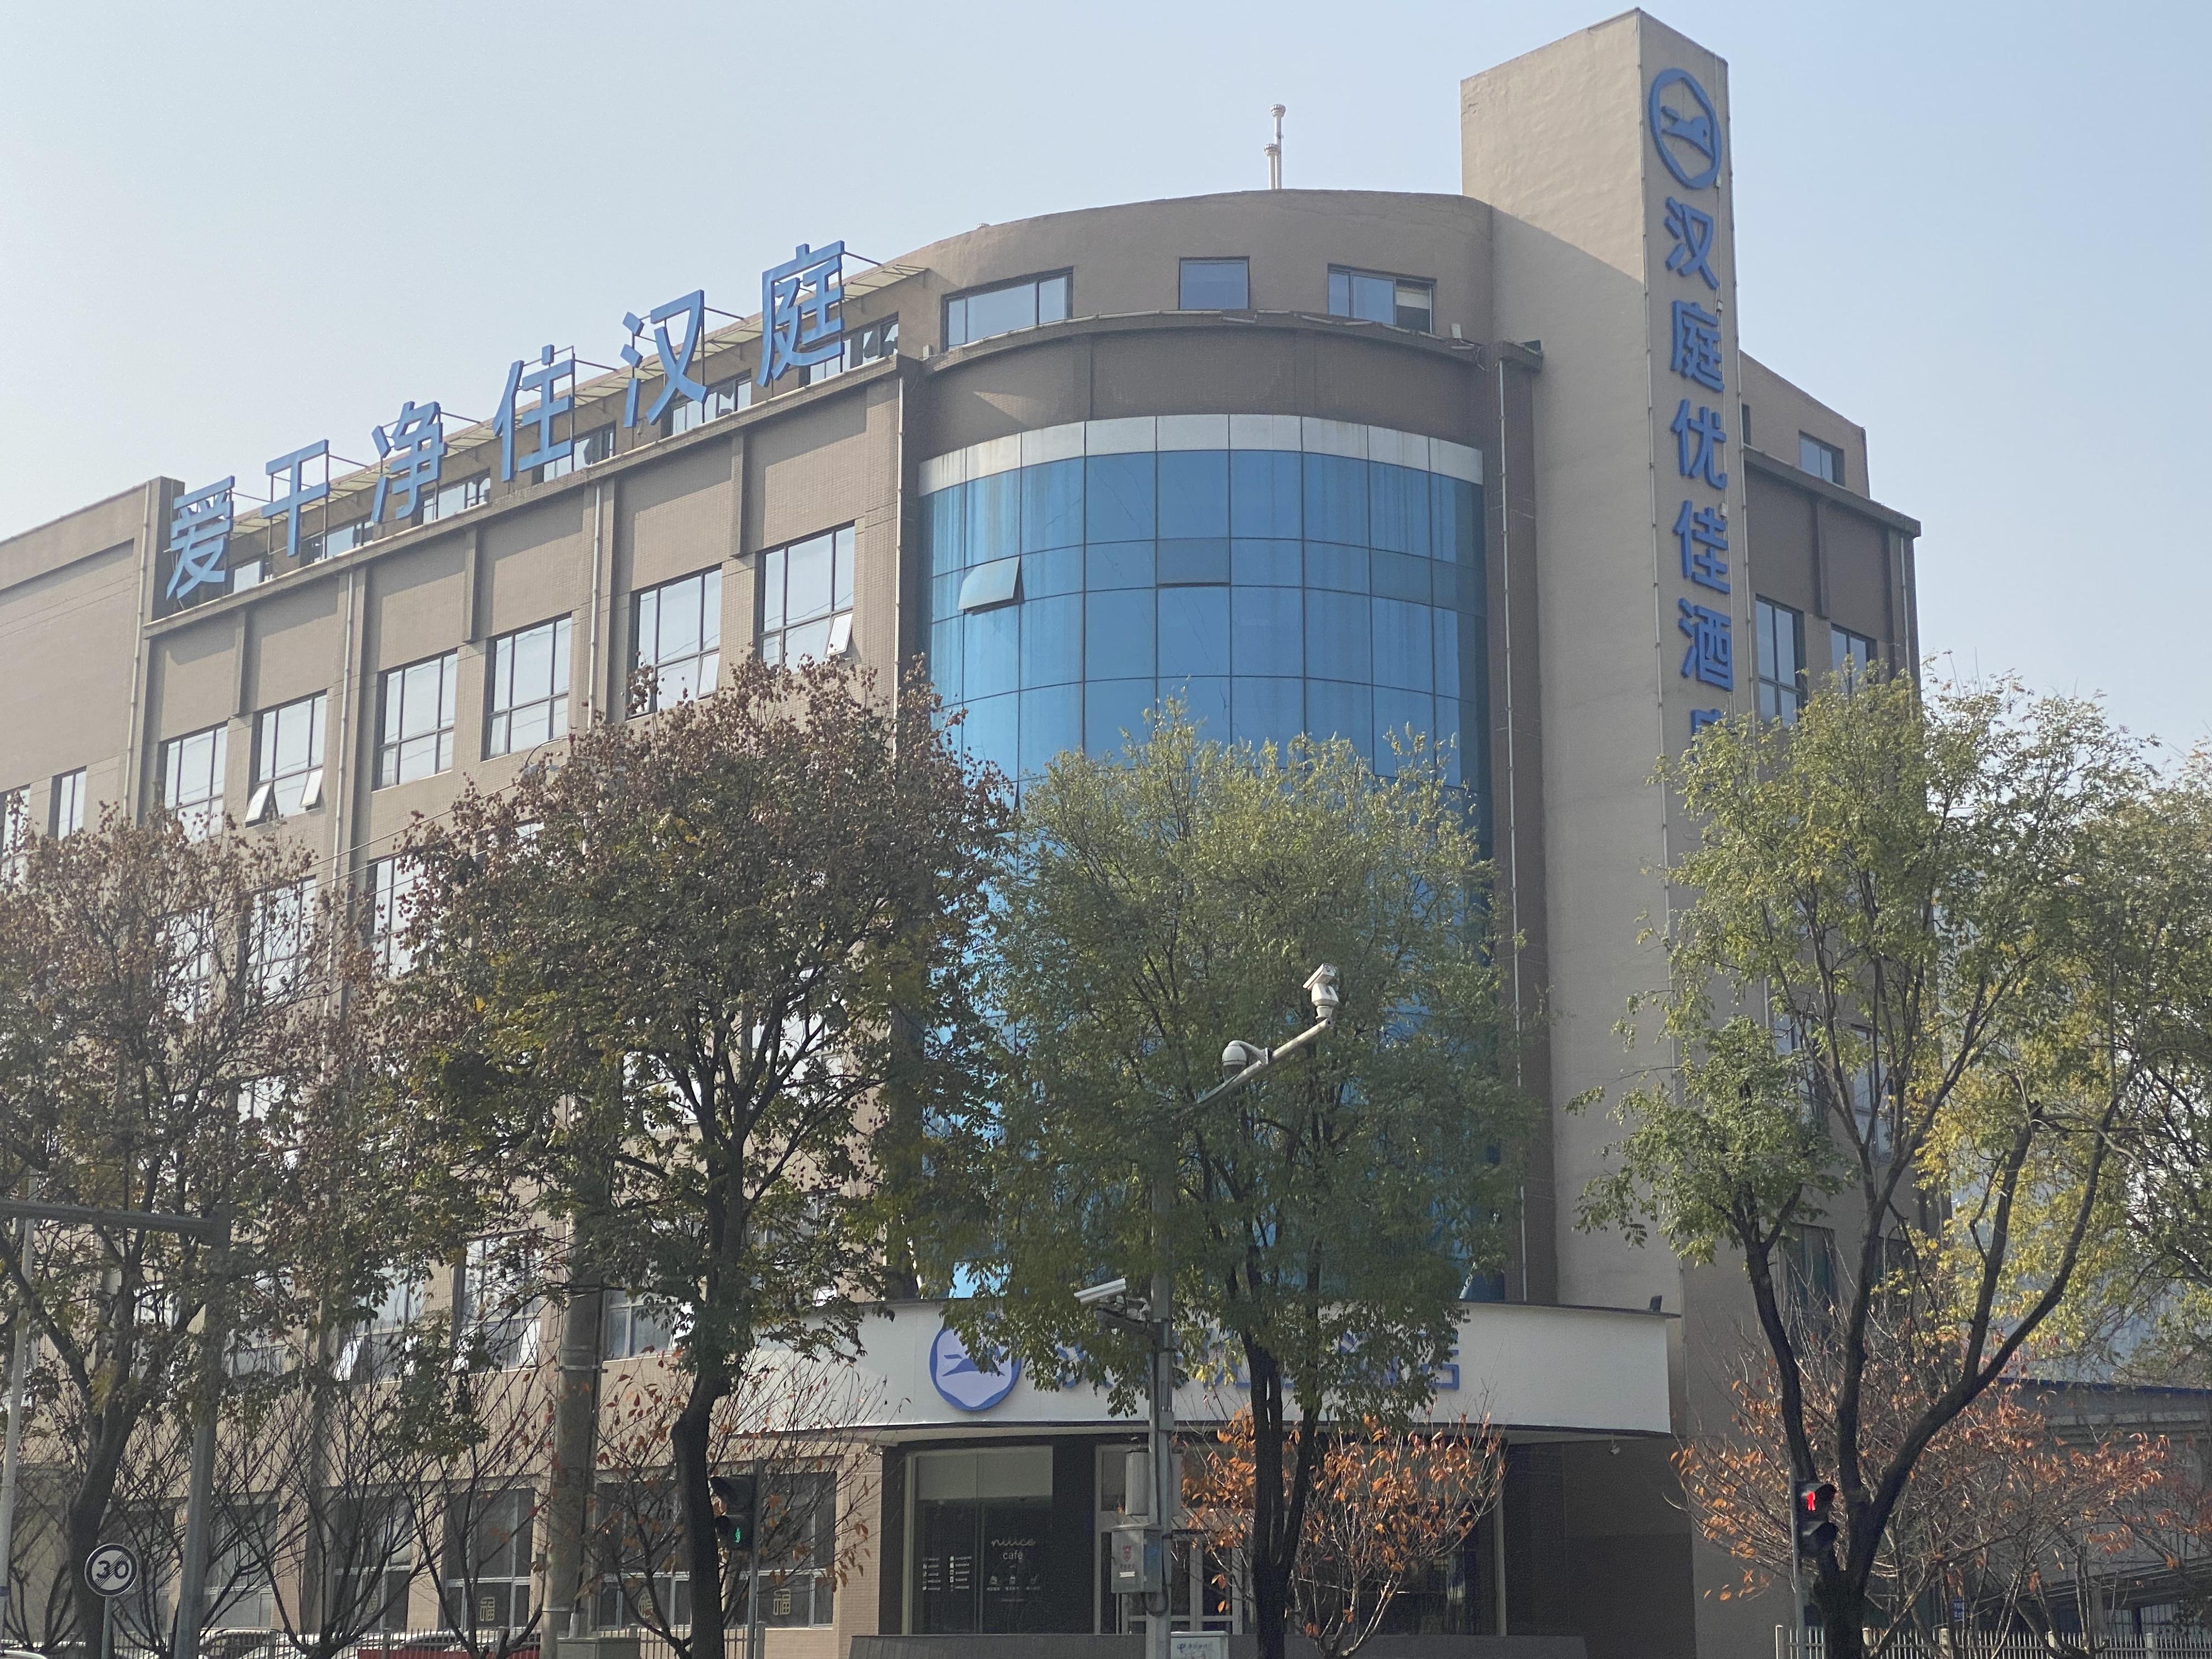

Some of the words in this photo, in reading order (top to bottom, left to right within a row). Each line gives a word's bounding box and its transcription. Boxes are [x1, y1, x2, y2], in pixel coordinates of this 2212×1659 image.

[166, 240, 845, 601] 爱干净住汉庭
[1664, 196, 1734, 764] 汉庭优佳酒
[97, 1560, 129, 1579] 30
[773, 1588, 791, 1616] 福
